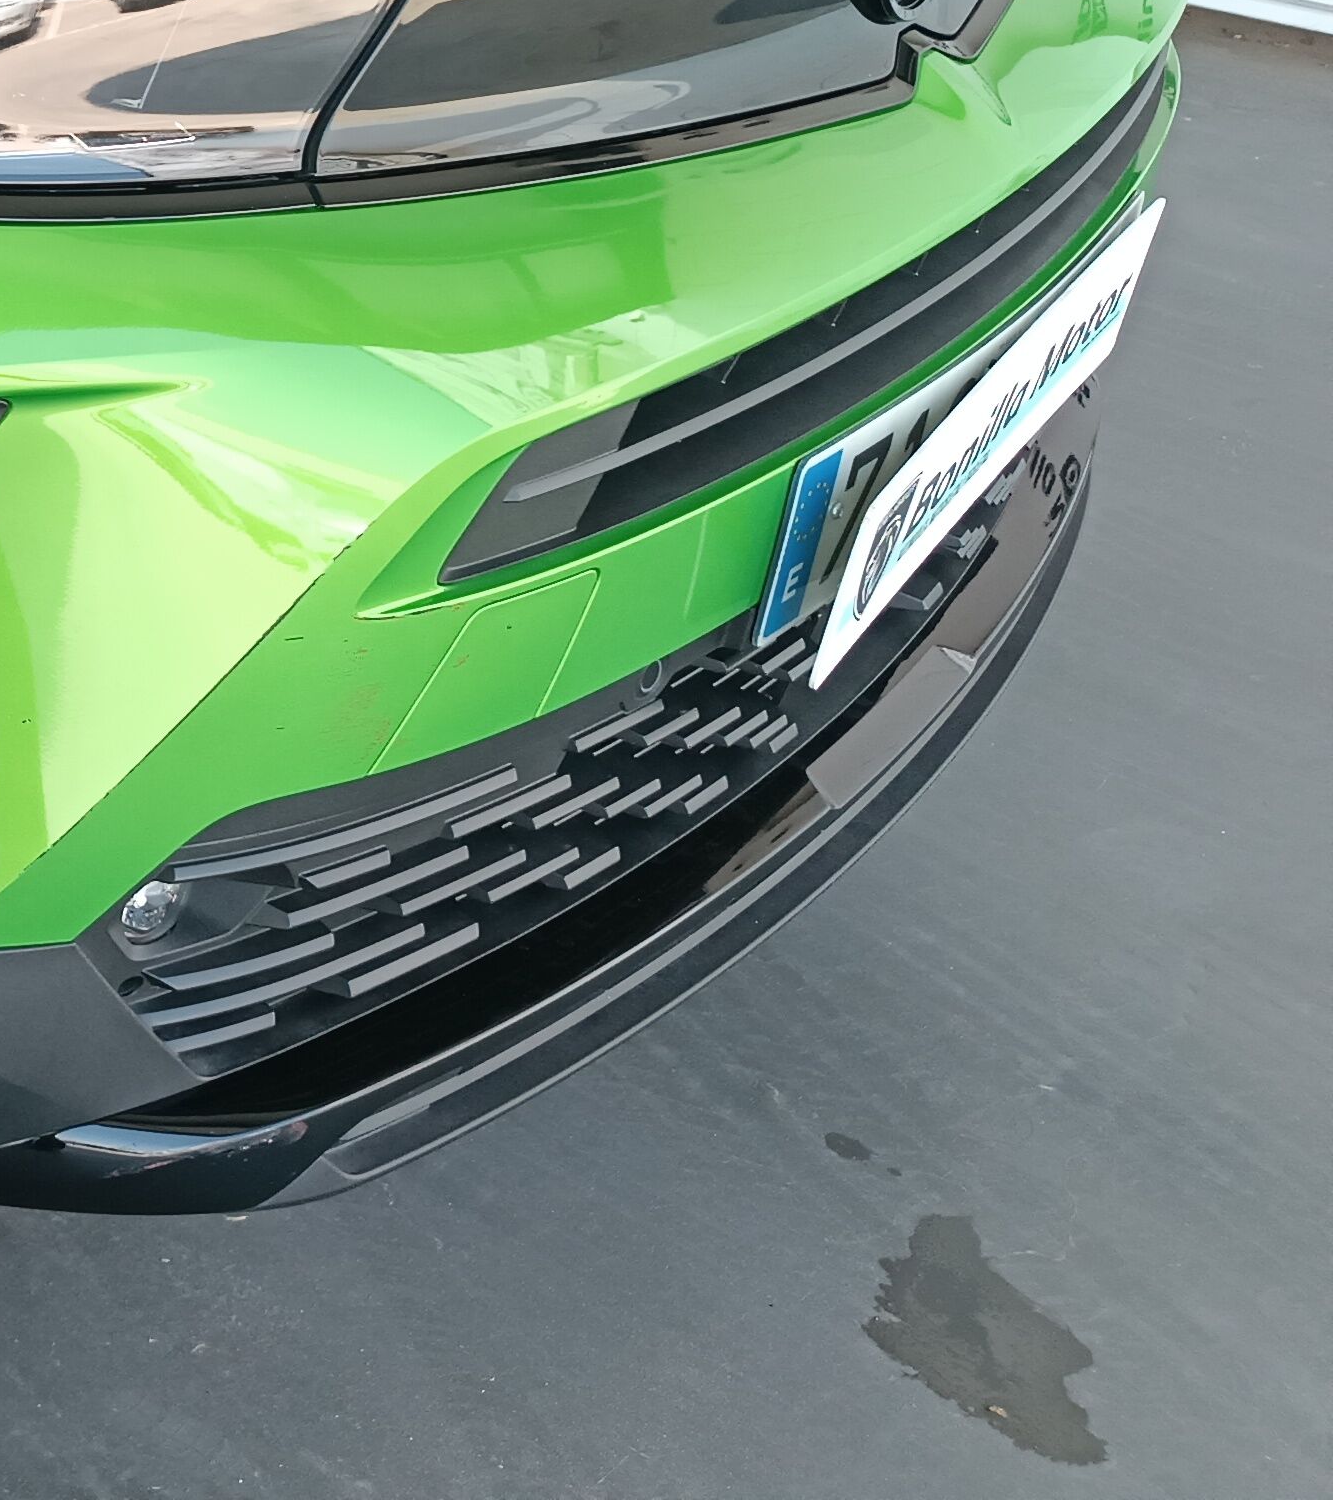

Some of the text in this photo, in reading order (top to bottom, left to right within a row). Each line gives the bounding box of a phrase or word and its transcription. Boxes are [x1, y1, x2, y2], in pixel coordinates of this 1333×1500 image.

[901, 379, 1031, 544] Bonilla
[1029, 272, 1133, 400] Motor
[781, 562, 804, 604] E
